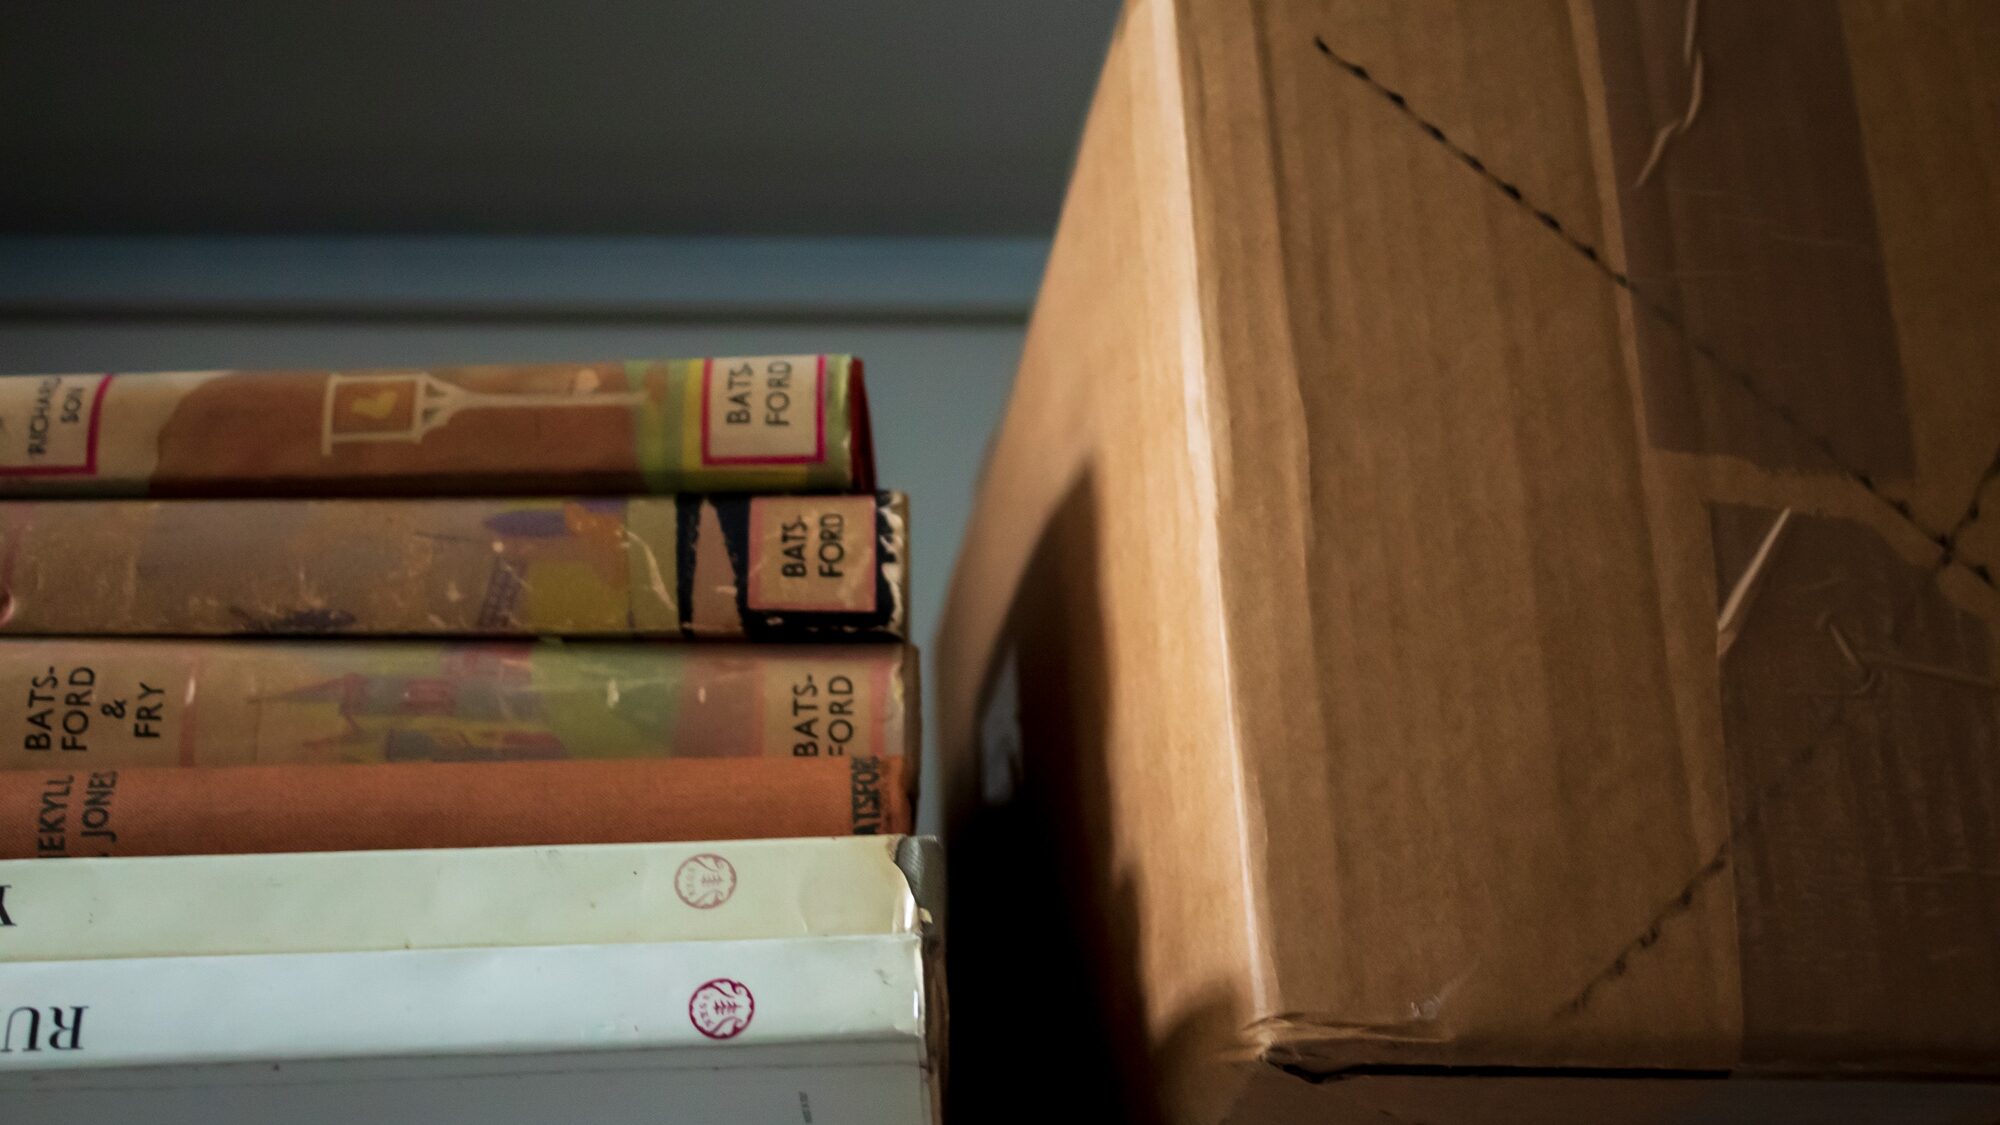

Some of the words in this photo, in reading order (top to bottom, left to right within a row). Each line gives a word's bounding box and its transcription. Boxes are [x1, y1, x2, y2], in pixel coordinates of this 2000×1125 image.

[765, 360, 792, 427] FORD
[818, 513, 845, 577] FORD
[24, 666, 58, 751] BATS-
[61, 666, 95, 751] FORD
[101, 699, 127, 719] &
[133, 682, 165, 738] FRY
[792, 674, 819, 757] BATS-
[37, 774, 75, 858] EKYLL
[0, 1005, 90, 1053] RU
